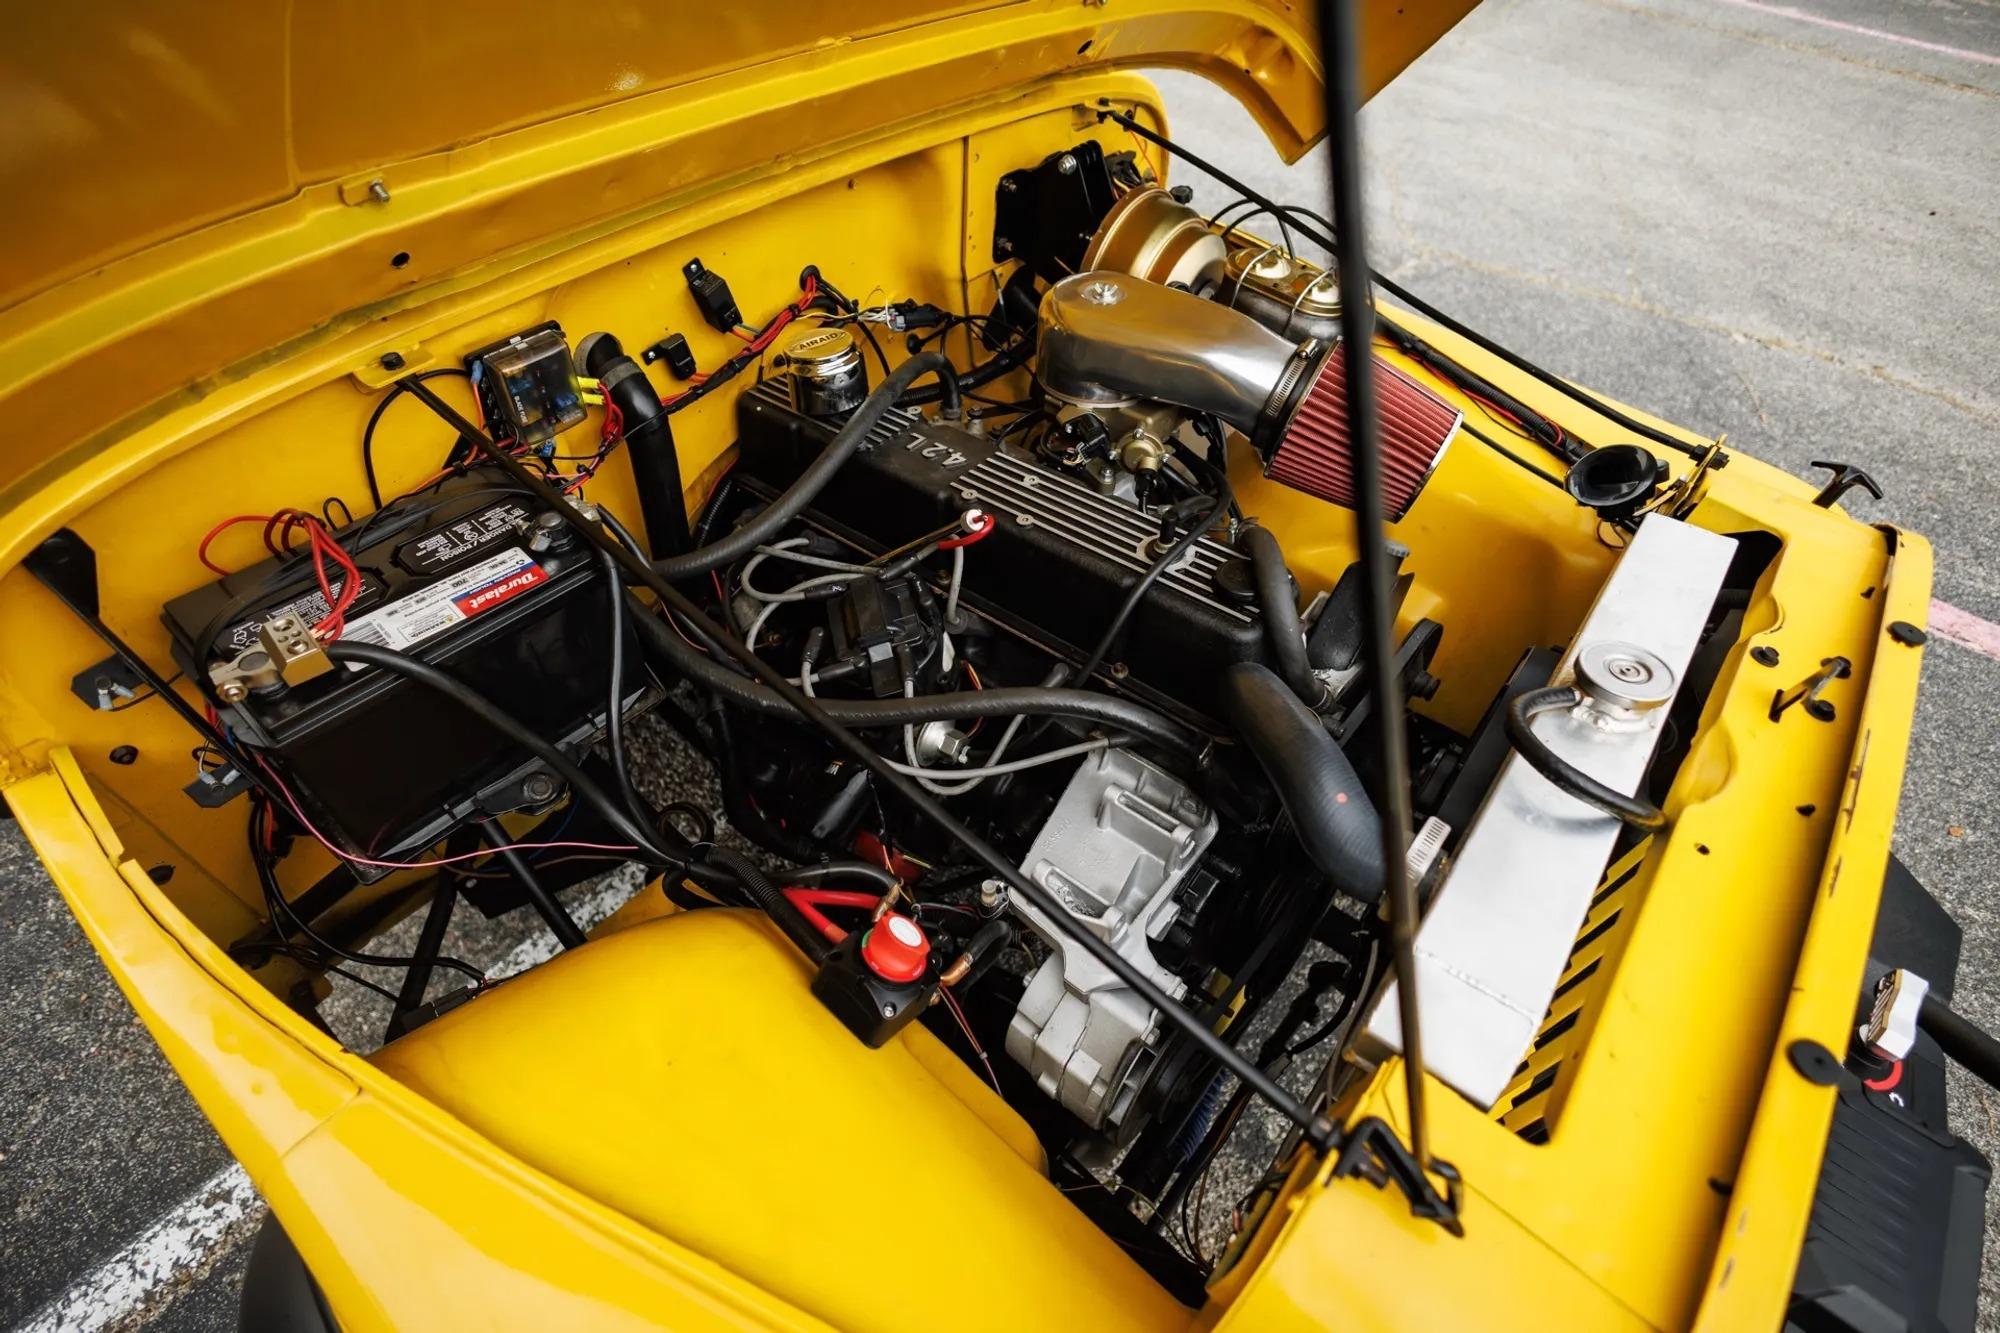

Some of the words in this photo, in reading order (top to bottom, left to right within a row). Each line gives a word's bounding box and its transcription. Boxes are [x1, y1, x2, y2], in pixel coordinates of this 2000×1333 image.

[799, 332, 838, 350] AIRAID
[478, 524, 512, 542] DANGER
[440, 543, 473, 561] POISON
[469, 572, 539, 609] Duralast
